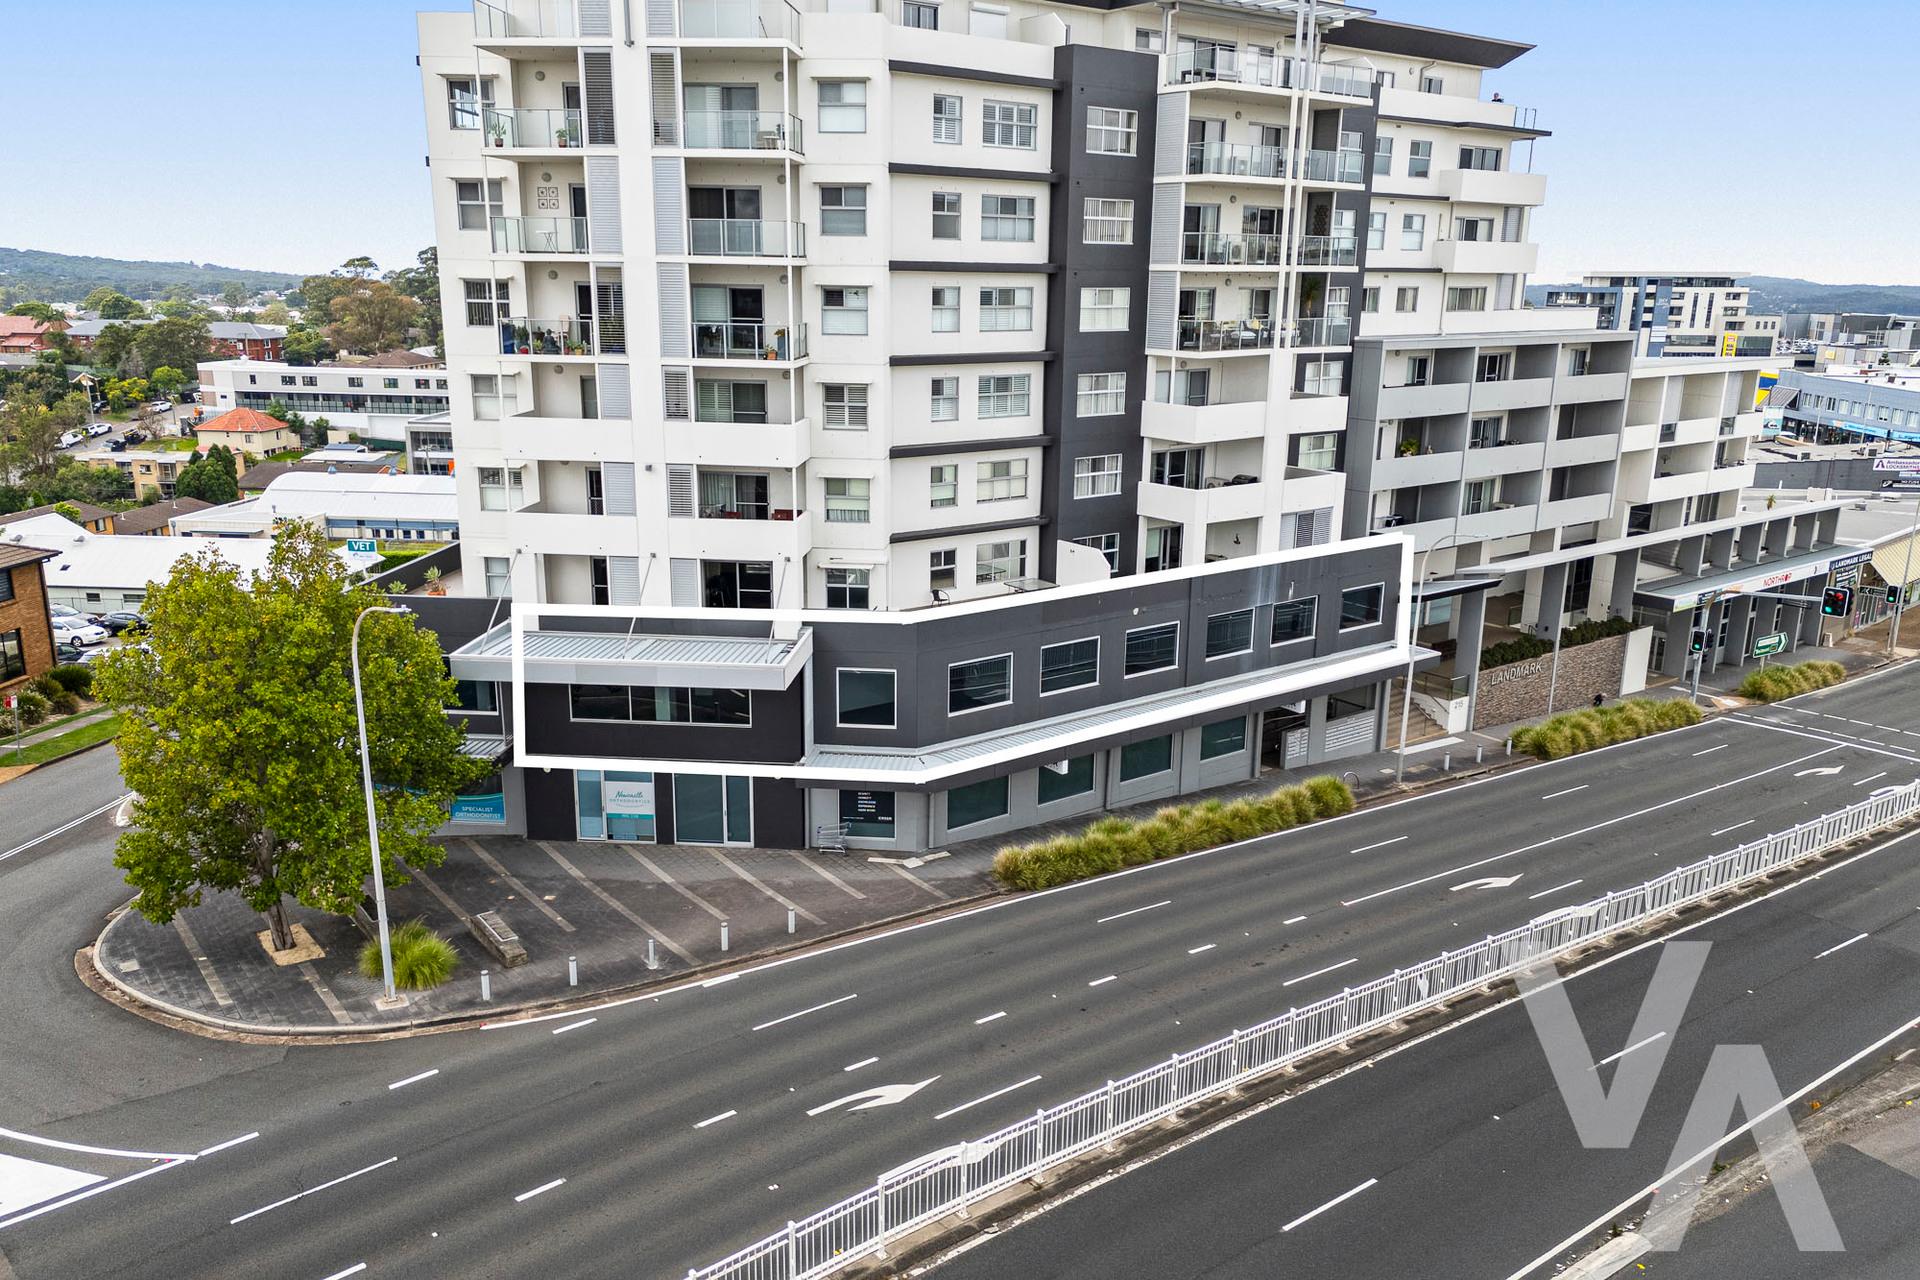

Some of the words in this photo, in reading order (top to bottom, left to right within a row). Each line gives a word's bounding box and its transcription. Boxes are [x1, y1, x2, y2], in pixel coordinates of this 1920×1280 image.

[351, 541, 371, 551] VET
[1835, 556, 1859, 568] LANDMARK
[1859, 552, 1872, 562] LEGAL
[1491, 661, 1542, 685] LANDMARK
